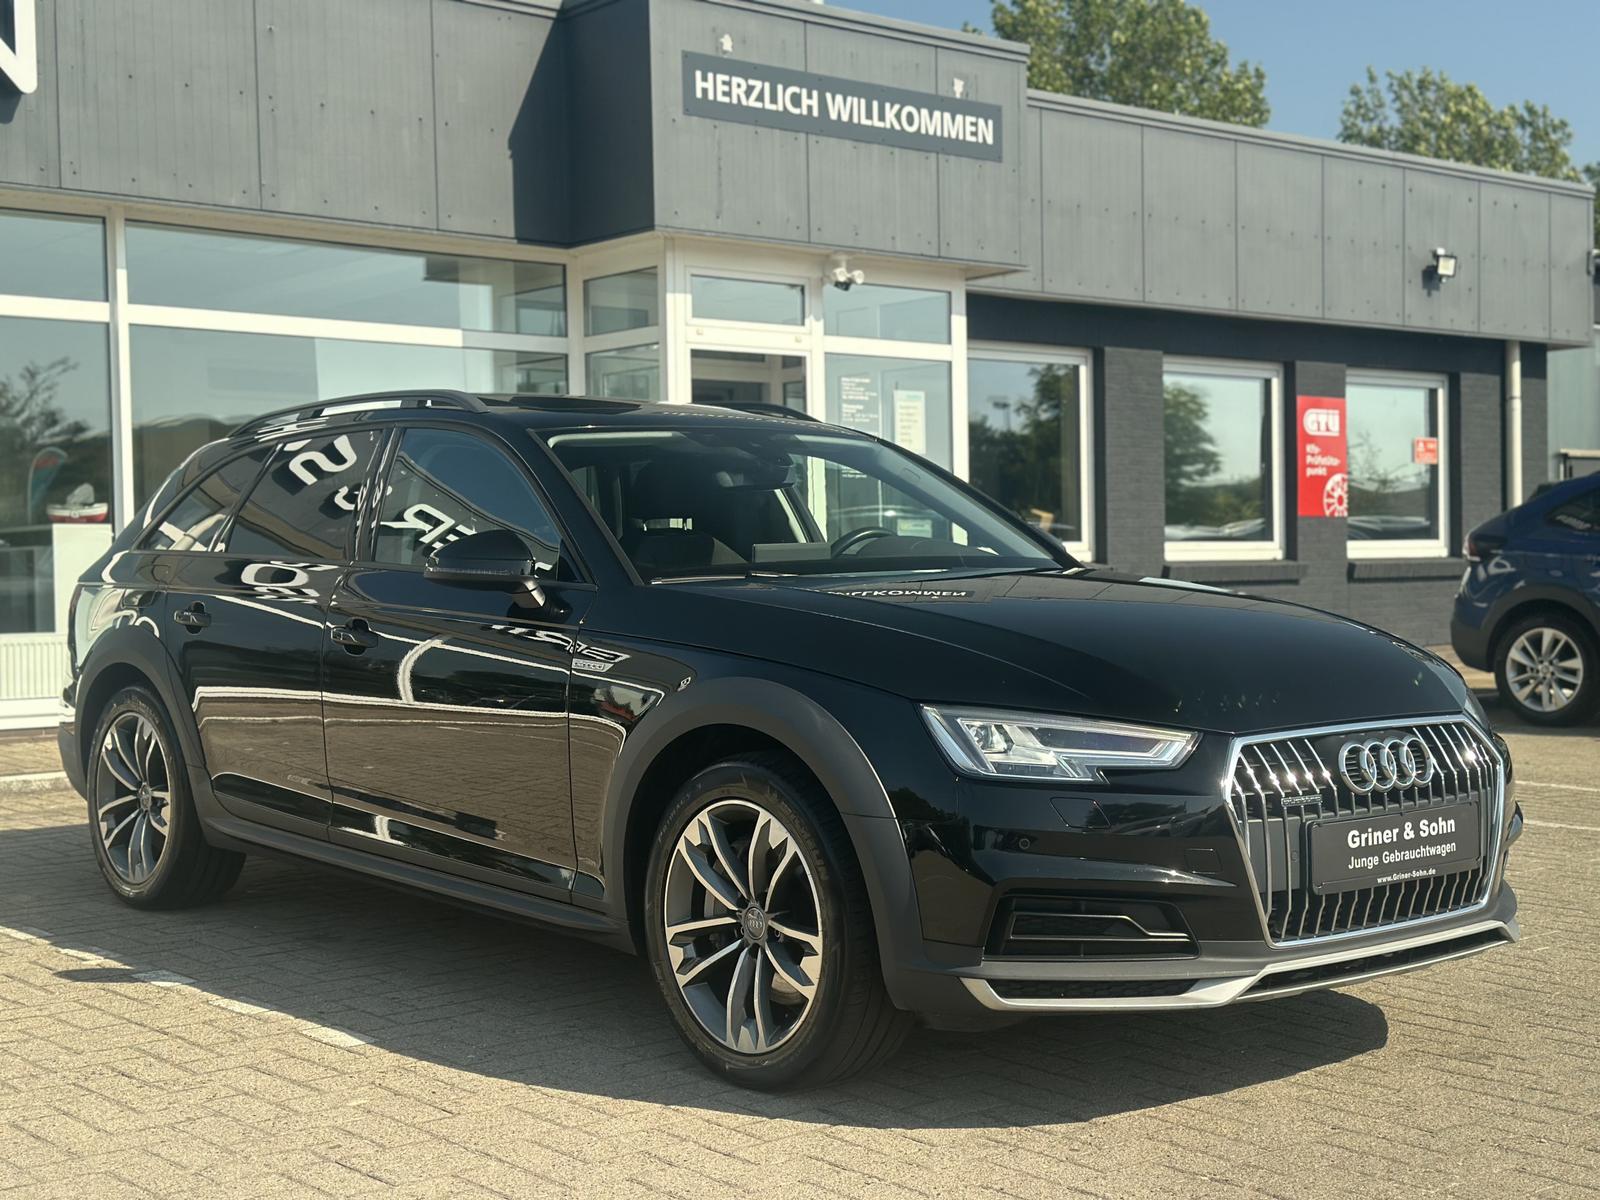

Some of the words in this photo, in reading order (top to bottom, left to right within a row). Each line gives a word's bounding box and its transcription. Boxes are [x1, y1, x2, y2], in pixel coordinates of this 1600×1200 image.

[695, 70, 819, 117] HERZLICH
[825, 92, 994, 145] WILLKOMMEN
[1347, 827, 1400, 849] Griner
[1403, 821, 1415, 840] &
[1419, 816, 1456, 838] Sohn
[1348, 856, 1380, 870] Junge
[1382, 842, 1457, 864] Gebrauchtwagen
[1376, 867, 1437, 884] www.Griner-Sohn.de
